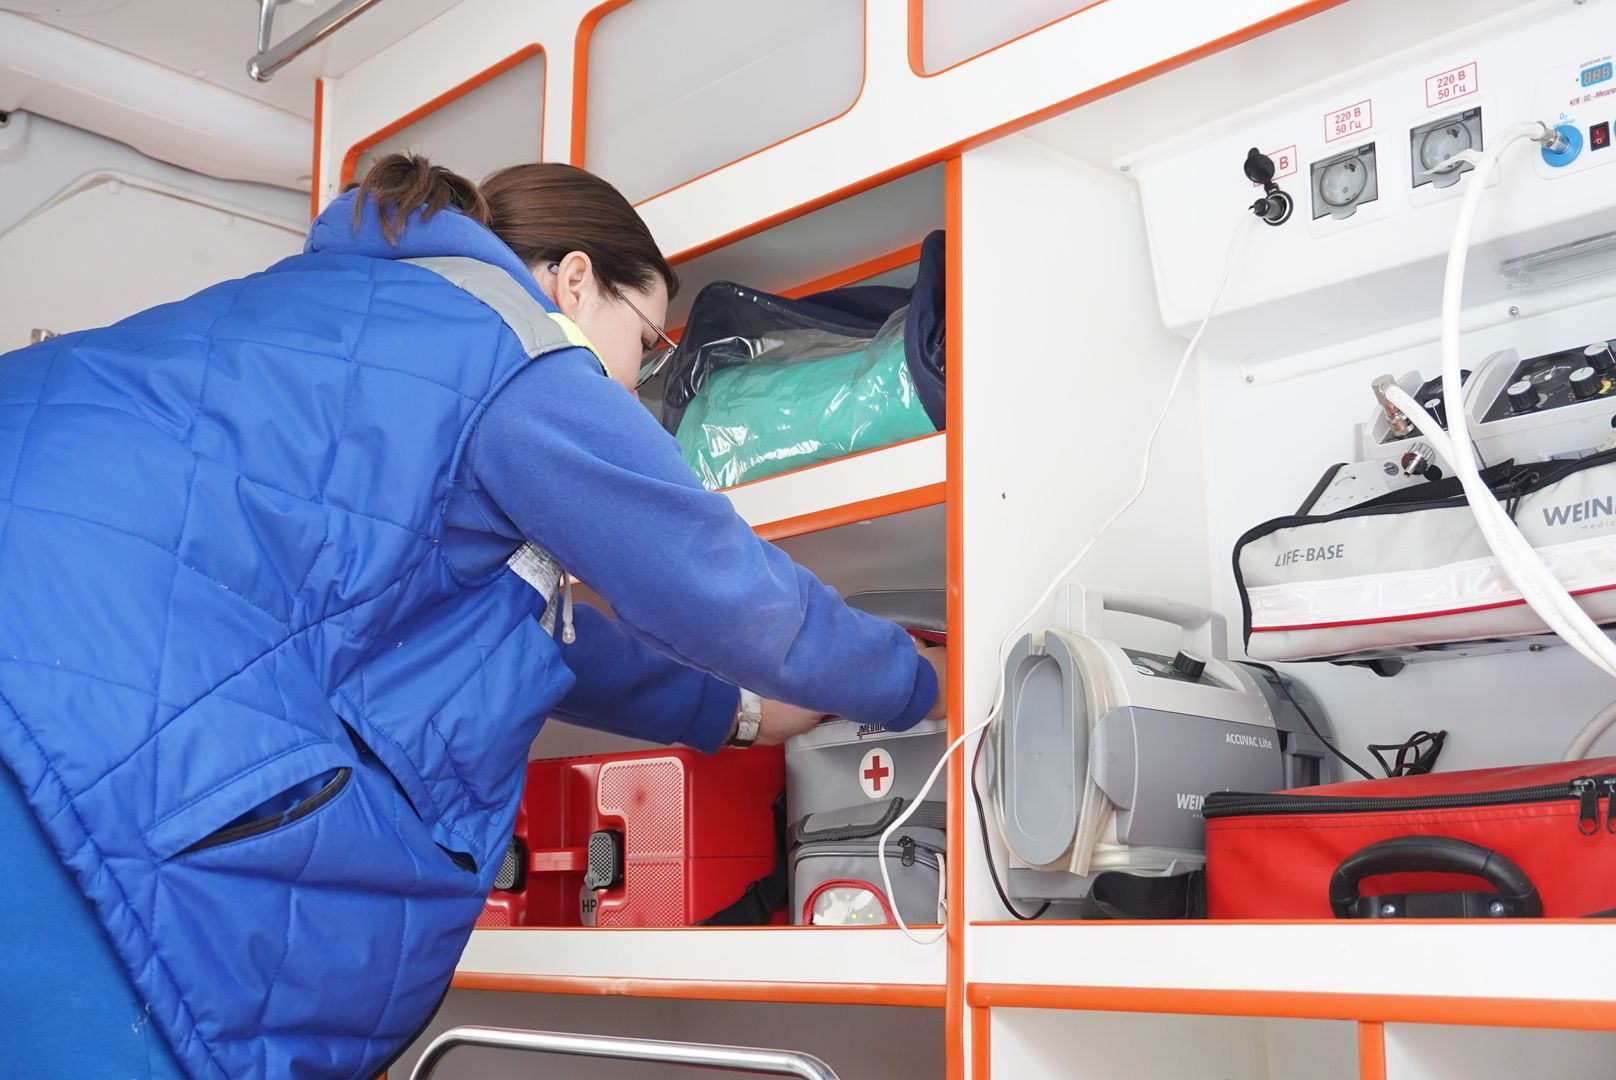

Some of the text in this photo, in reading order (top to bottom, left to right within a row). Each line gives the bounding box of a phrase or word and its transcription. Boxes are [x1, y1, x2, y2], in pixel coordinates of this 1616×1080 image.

[1437, 74, 1455, 88] 220
[1438, 84, 1466, 100] 50 Гц
[1335, 111, 1351, 124] 220
[1336, 120, 1362, 135] 50 Гц
[1542, 495, 1616, 527] WEIN
[1274, 543, 1345, 567] LIFE-BASE
[1225, 733, 1273, 750] ACCUVAC Lite
[582, 899, 597, 913] HP
